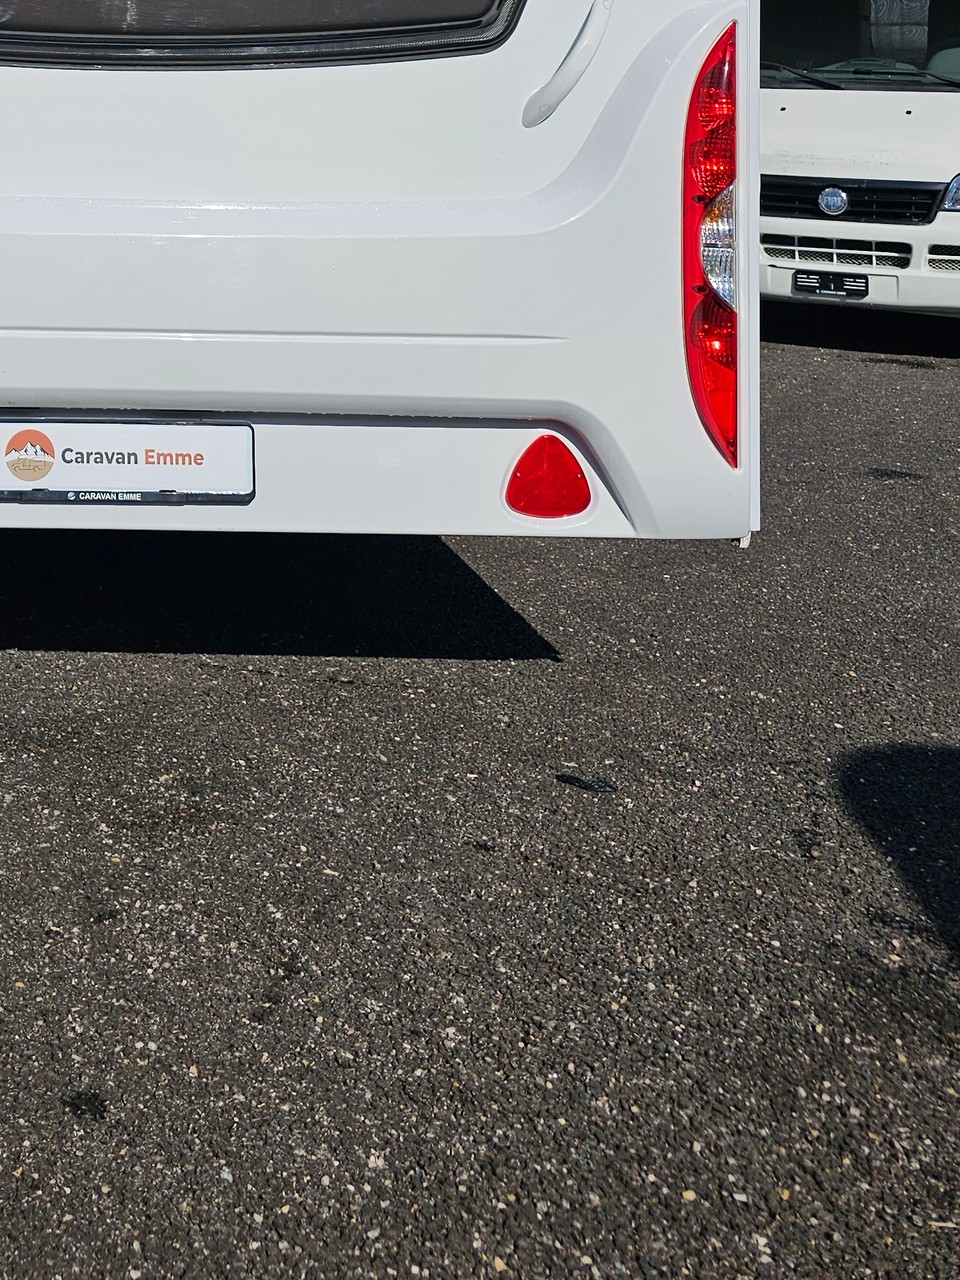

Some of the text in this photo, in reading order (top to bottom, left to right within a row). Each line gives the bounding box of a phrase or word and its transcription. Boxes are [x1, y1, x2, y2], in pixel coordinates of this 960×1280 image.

[61, 447, 204, 466] Caravan Emme
[79, 492, 142, 501] CARAVAN EMME
